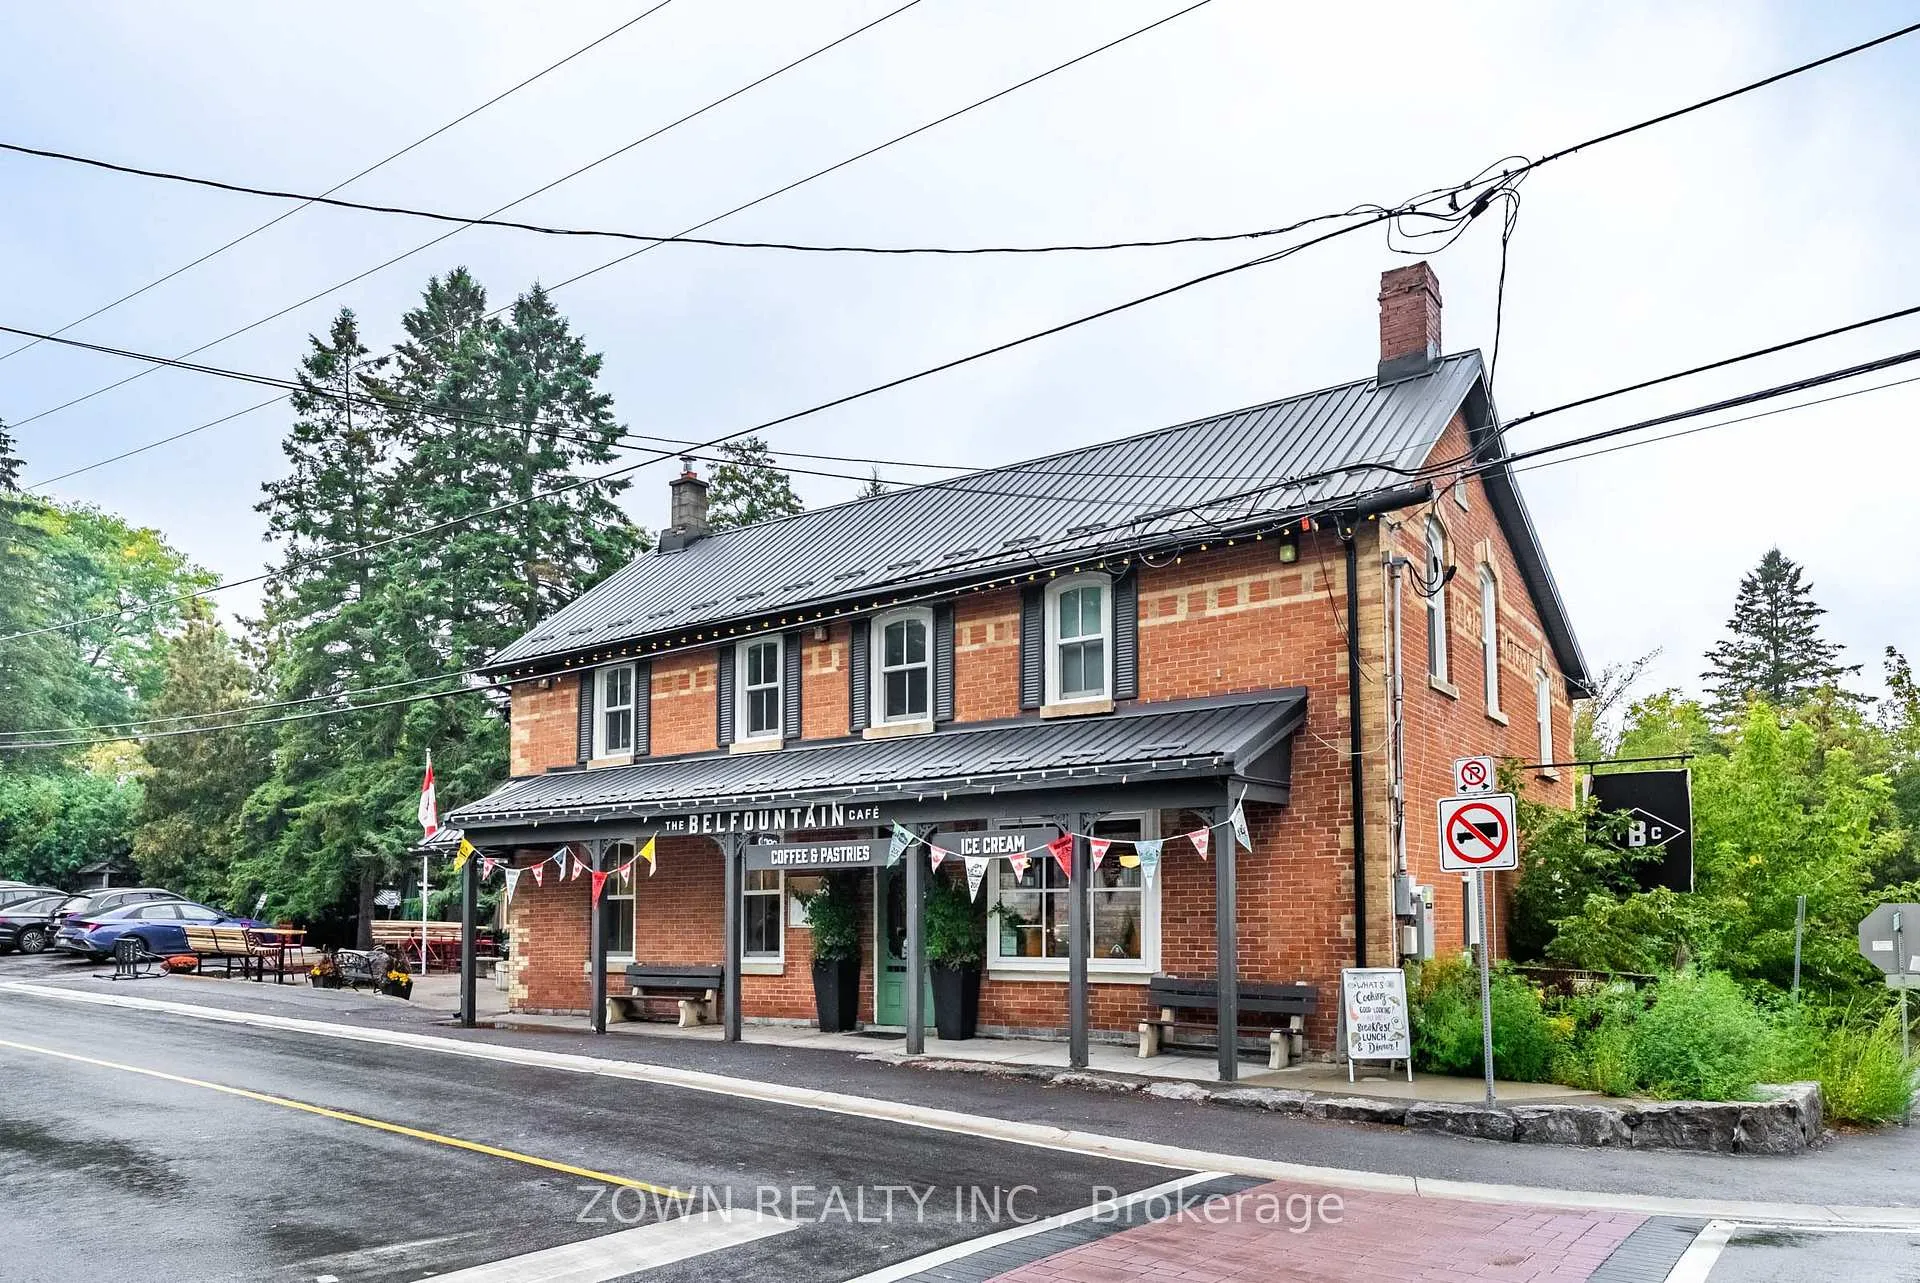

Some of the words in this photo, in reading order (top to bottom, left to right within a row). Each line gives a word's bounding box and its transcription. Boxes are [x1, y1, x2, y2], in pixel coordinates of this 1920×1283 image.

[665, 820, 684, 831] THE
[688, 805, 844, 834] BELFOUNTAIN
[848, 806, 880, 820] CAFÉ
[960, 837, 980, 855] ICE
[982, 834, 1026, 854] CREAM
[770, 848, 809, 865] COFFEE
[810, 847, 819, 863] &
[820, 845, 870, 863] PASTRIES
[1357, 1021, 1390, 1033] Breakfast
[1362, 1032, 1387, 1042] LUNCH
[1357, 1042, 1363, 1052] &
